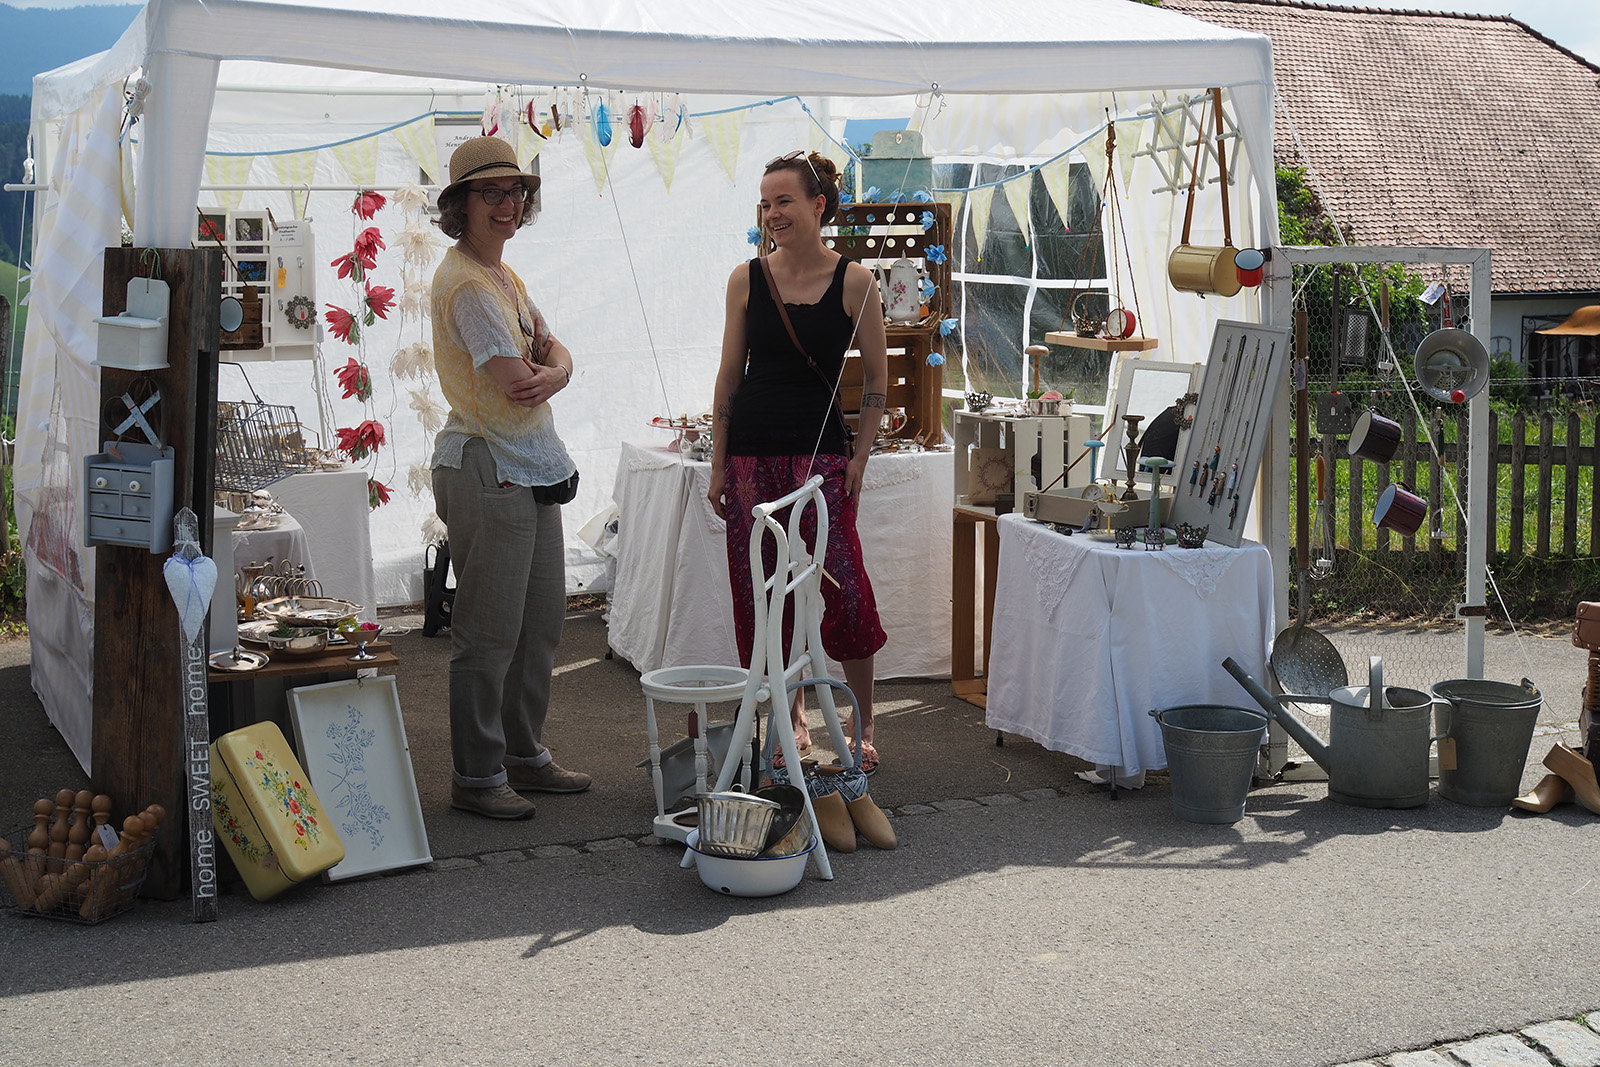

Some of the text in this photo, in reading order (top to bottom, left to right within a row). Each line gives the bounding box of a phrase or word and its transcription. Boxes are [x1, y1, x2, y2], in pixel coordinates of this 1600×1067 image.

[188, 646, 216, 899] home SWEET home
